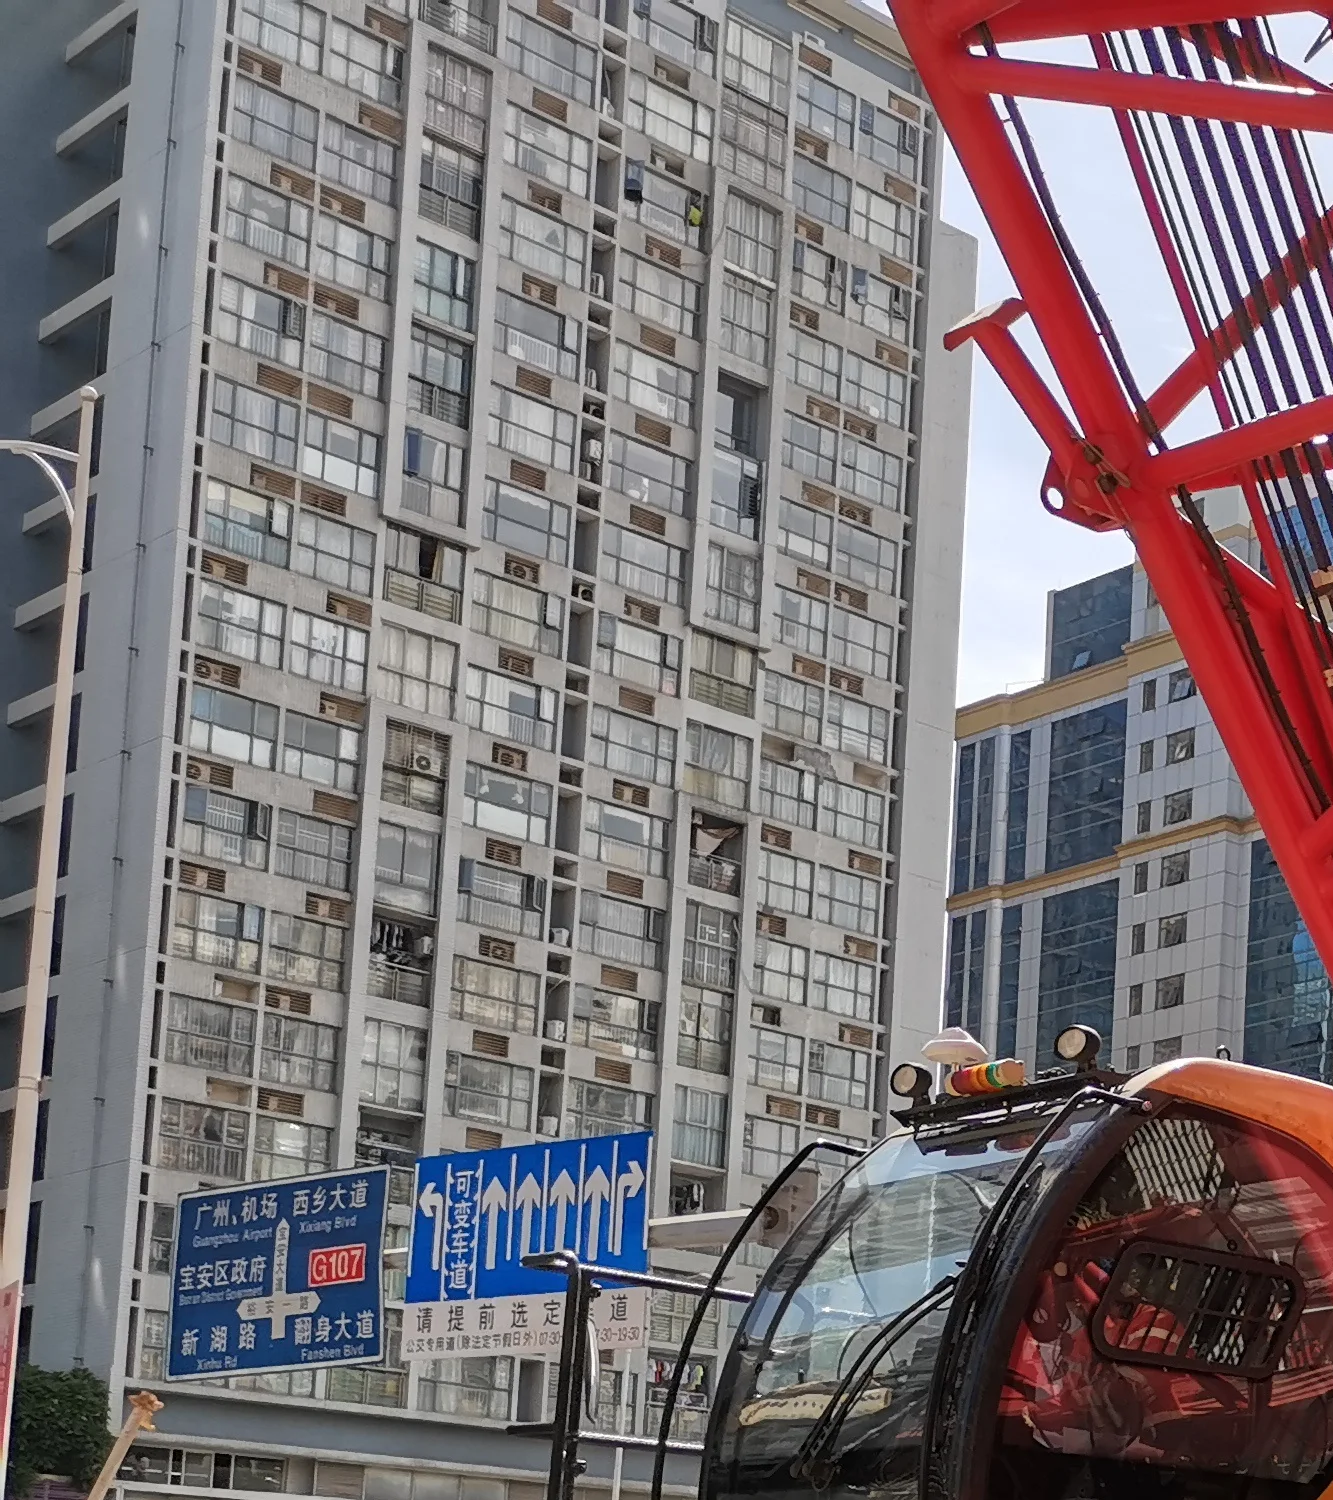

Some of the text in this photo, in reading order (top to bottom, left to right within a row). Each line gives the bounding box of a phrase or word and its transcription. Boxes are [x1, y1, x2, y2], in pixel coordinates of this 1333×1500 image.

[194, 1193, 279, 1231] 广州、机场
[293, 1179, 369, 1217] 西乡大道
[243, 1227, 272, 1243] Airport
[334, 1215, 357, 1228] Blvd
[449, 1170, 474, 1290] 可变车道
[179, 1255, 267, 1291] 宝安区政府
[312, 1249, 363, 1281] G107
[294, 1310, 375, 1346] 翻身大道
[416, 1294, 628, 1334] 请提前选定道
[180, 1323, 256, 1356] 新湖路
[343, 1343, 364, 1357] Blvd
[225, 1355, 238, 1368] Rd
